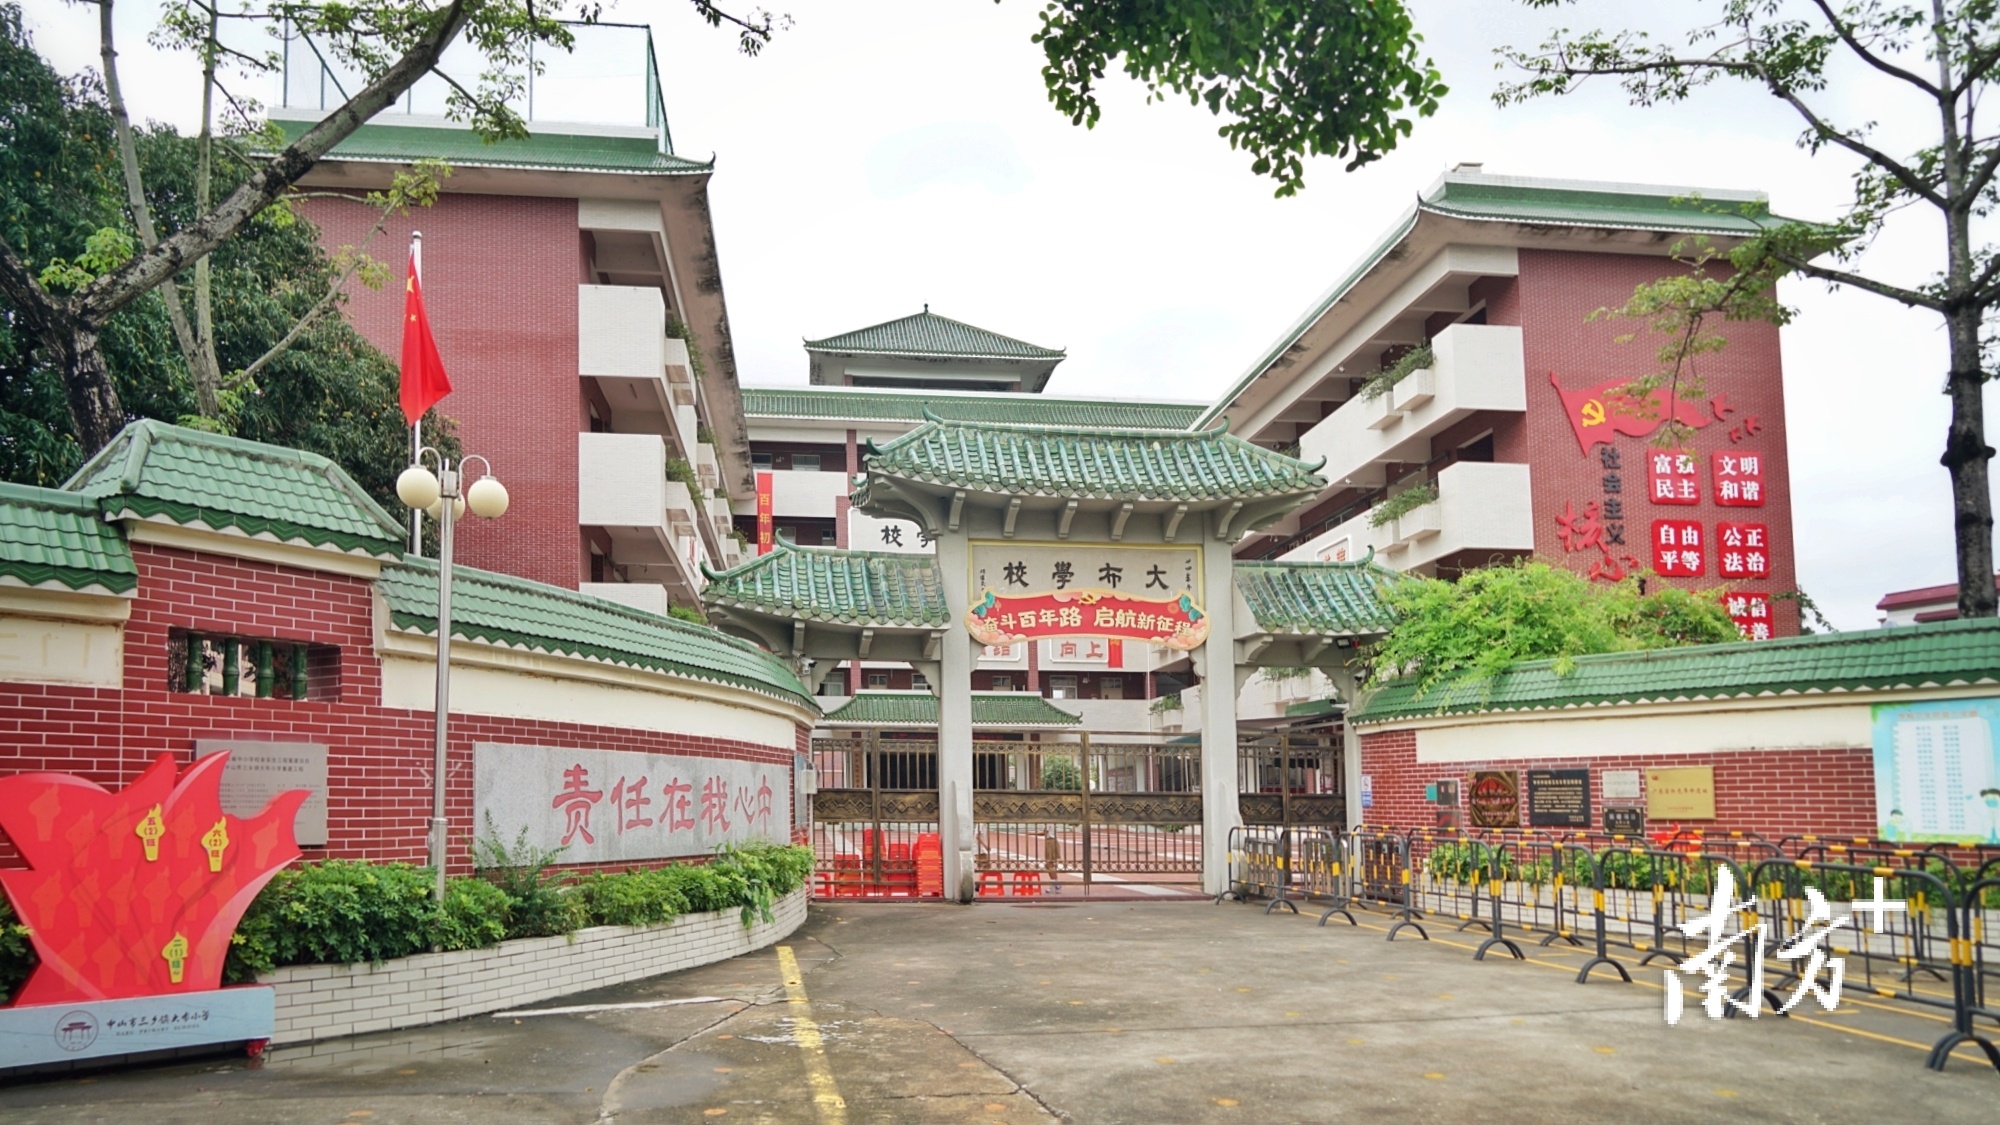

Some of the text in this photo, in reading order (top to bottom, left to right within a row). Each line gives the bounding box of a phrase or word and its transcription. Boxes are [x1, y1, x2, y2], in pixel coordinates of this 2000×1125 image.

[1654, 454, 1695, 475] 富强
[1719, 456, 1759, 475] 文明
[1600, 447, 1625, 545] 社会主义
[1655, 479, 1696, 499] 民主
[1720, 481, 1760, 501] 和谐
[759, 492, 771, 556] 百年初
[1659, 525, 1699, 545] 自由
[1723, 528, 1763, 548] 公正
[1660, 551, 1700, 571] 平等
[1723, 552, 1765, 572] 法治
[983, 606, 1192, 636] 奋斗百年路 启航新征程
[1060, 641, 1103, 658] 向上
[552, 763, 772, 845] 责任在我心中
